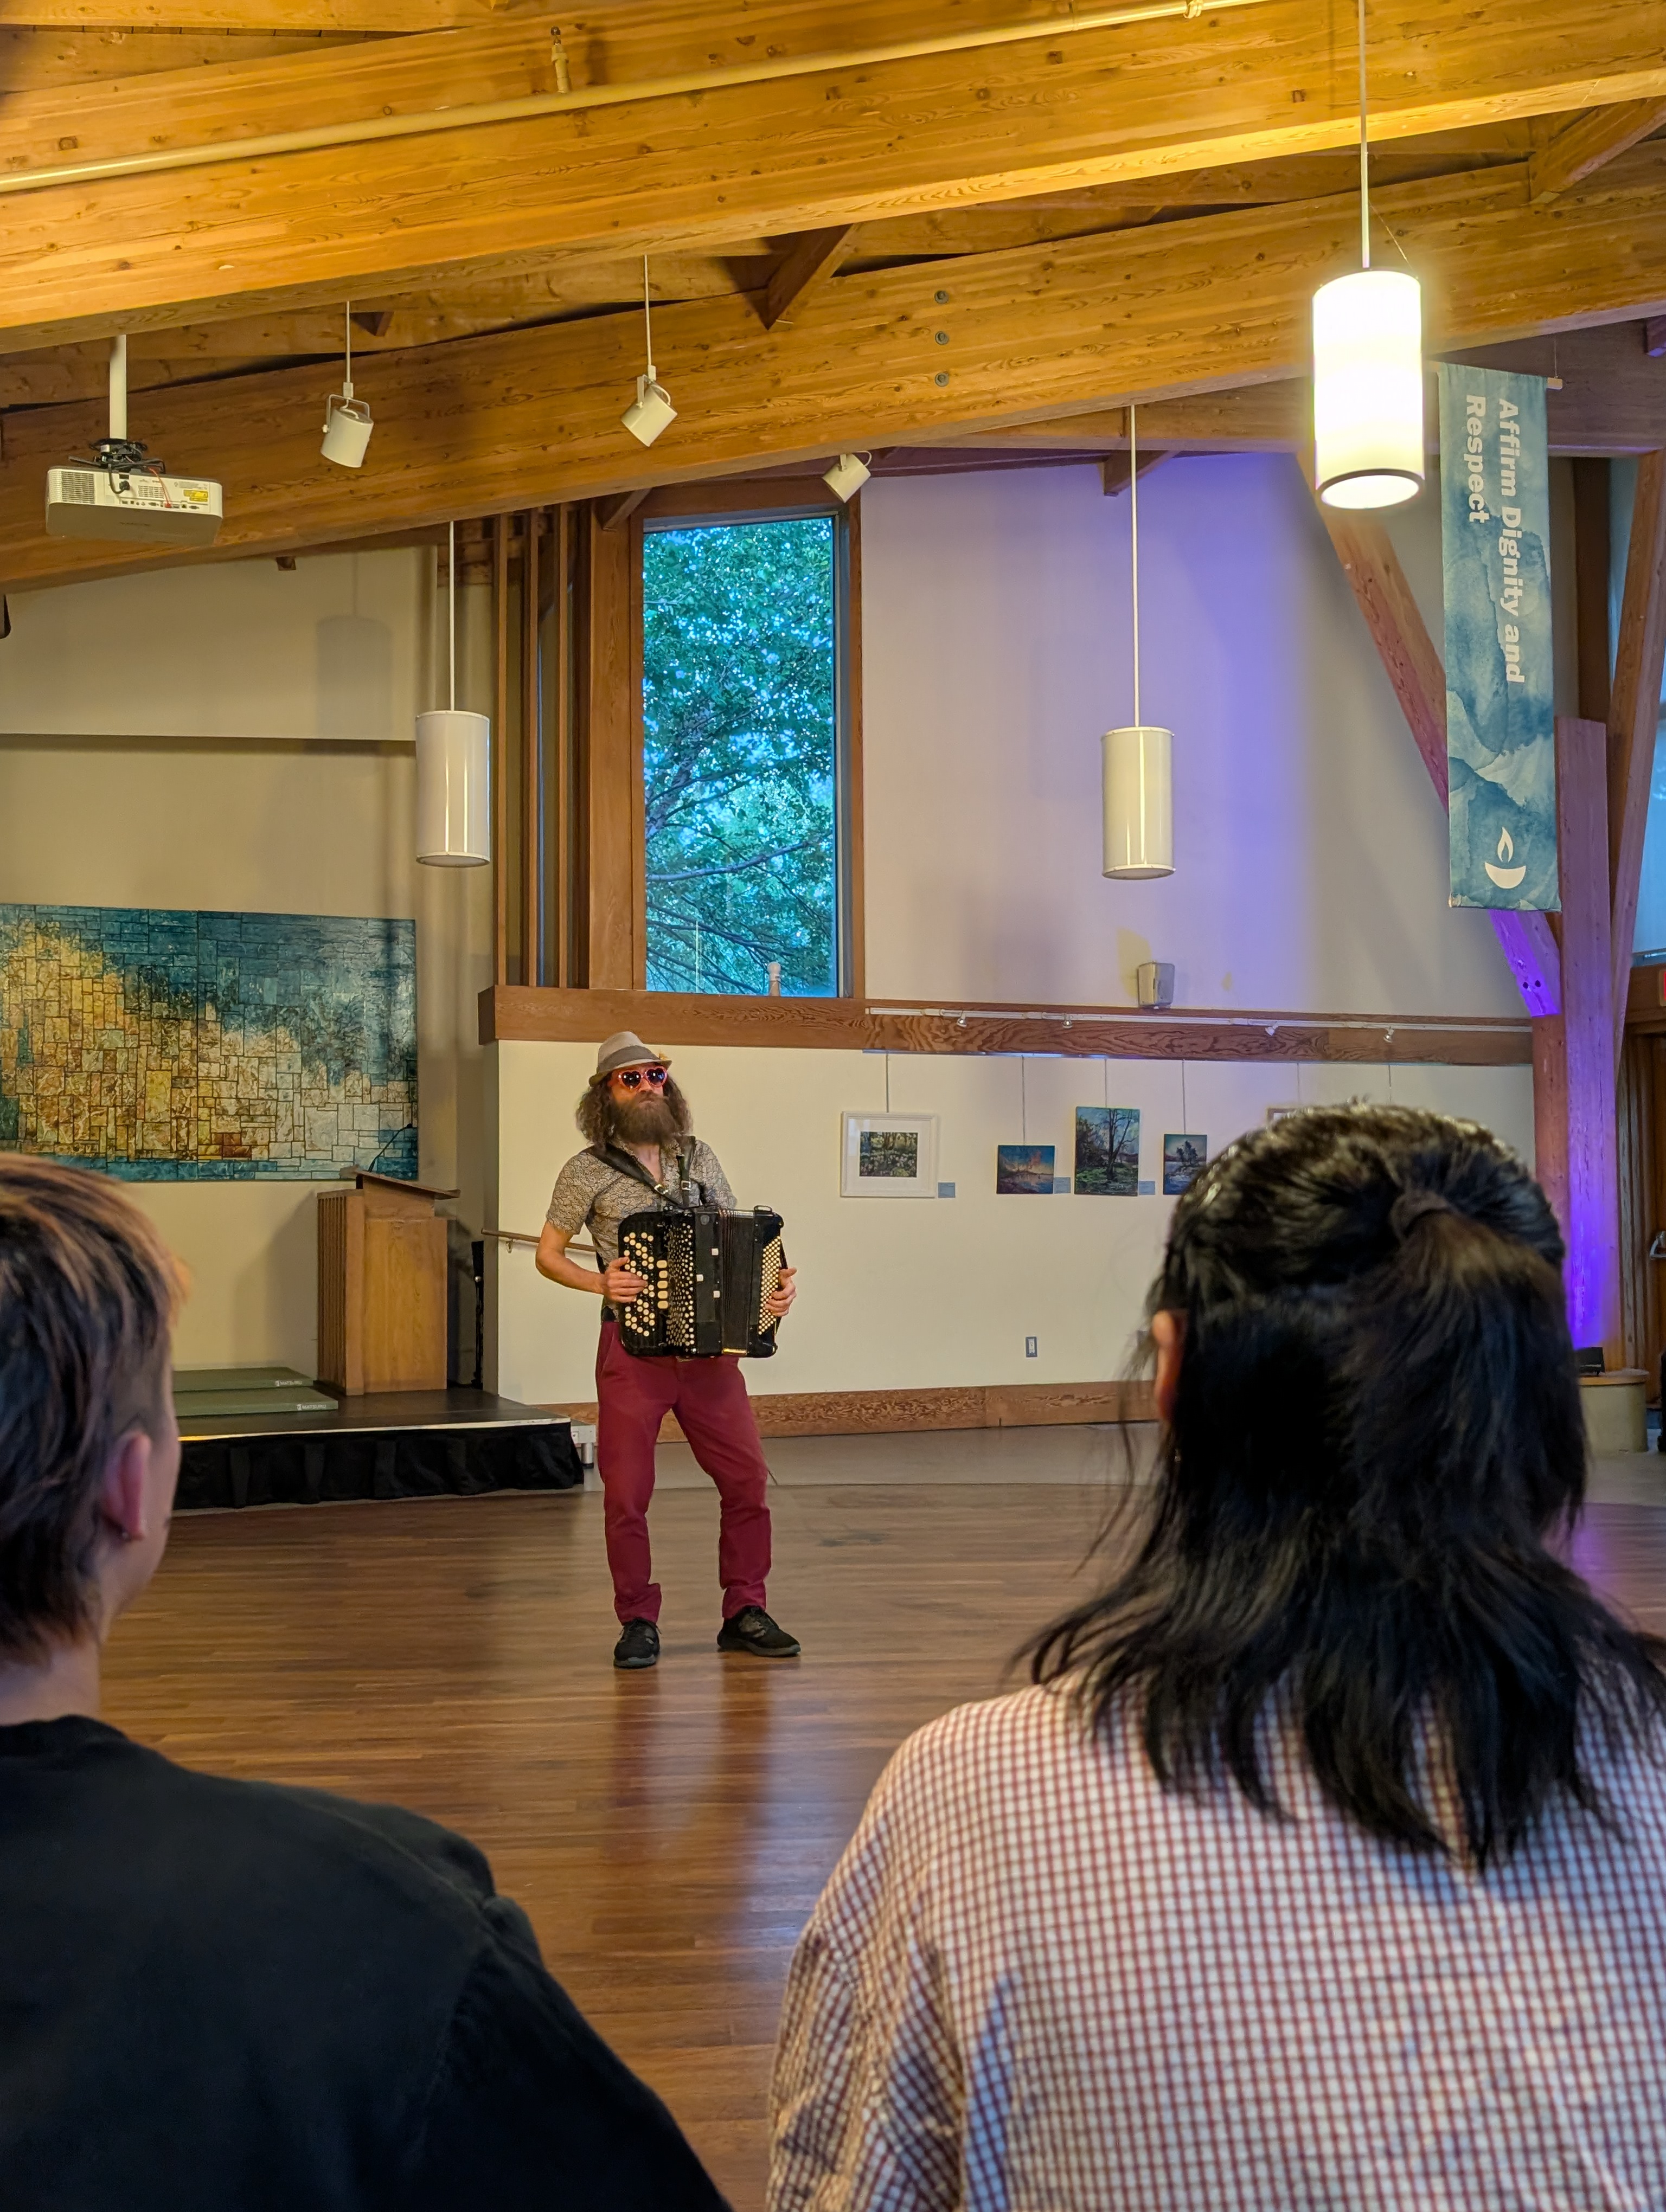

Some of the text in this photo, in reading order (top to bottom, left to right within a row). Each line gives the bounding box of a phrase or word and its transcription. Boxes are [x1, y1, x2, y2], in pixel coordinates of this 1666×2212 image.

[1464, 395, 1490, 524] Respect
[1499, 398, 1525, 683] Affirm Dignity and
